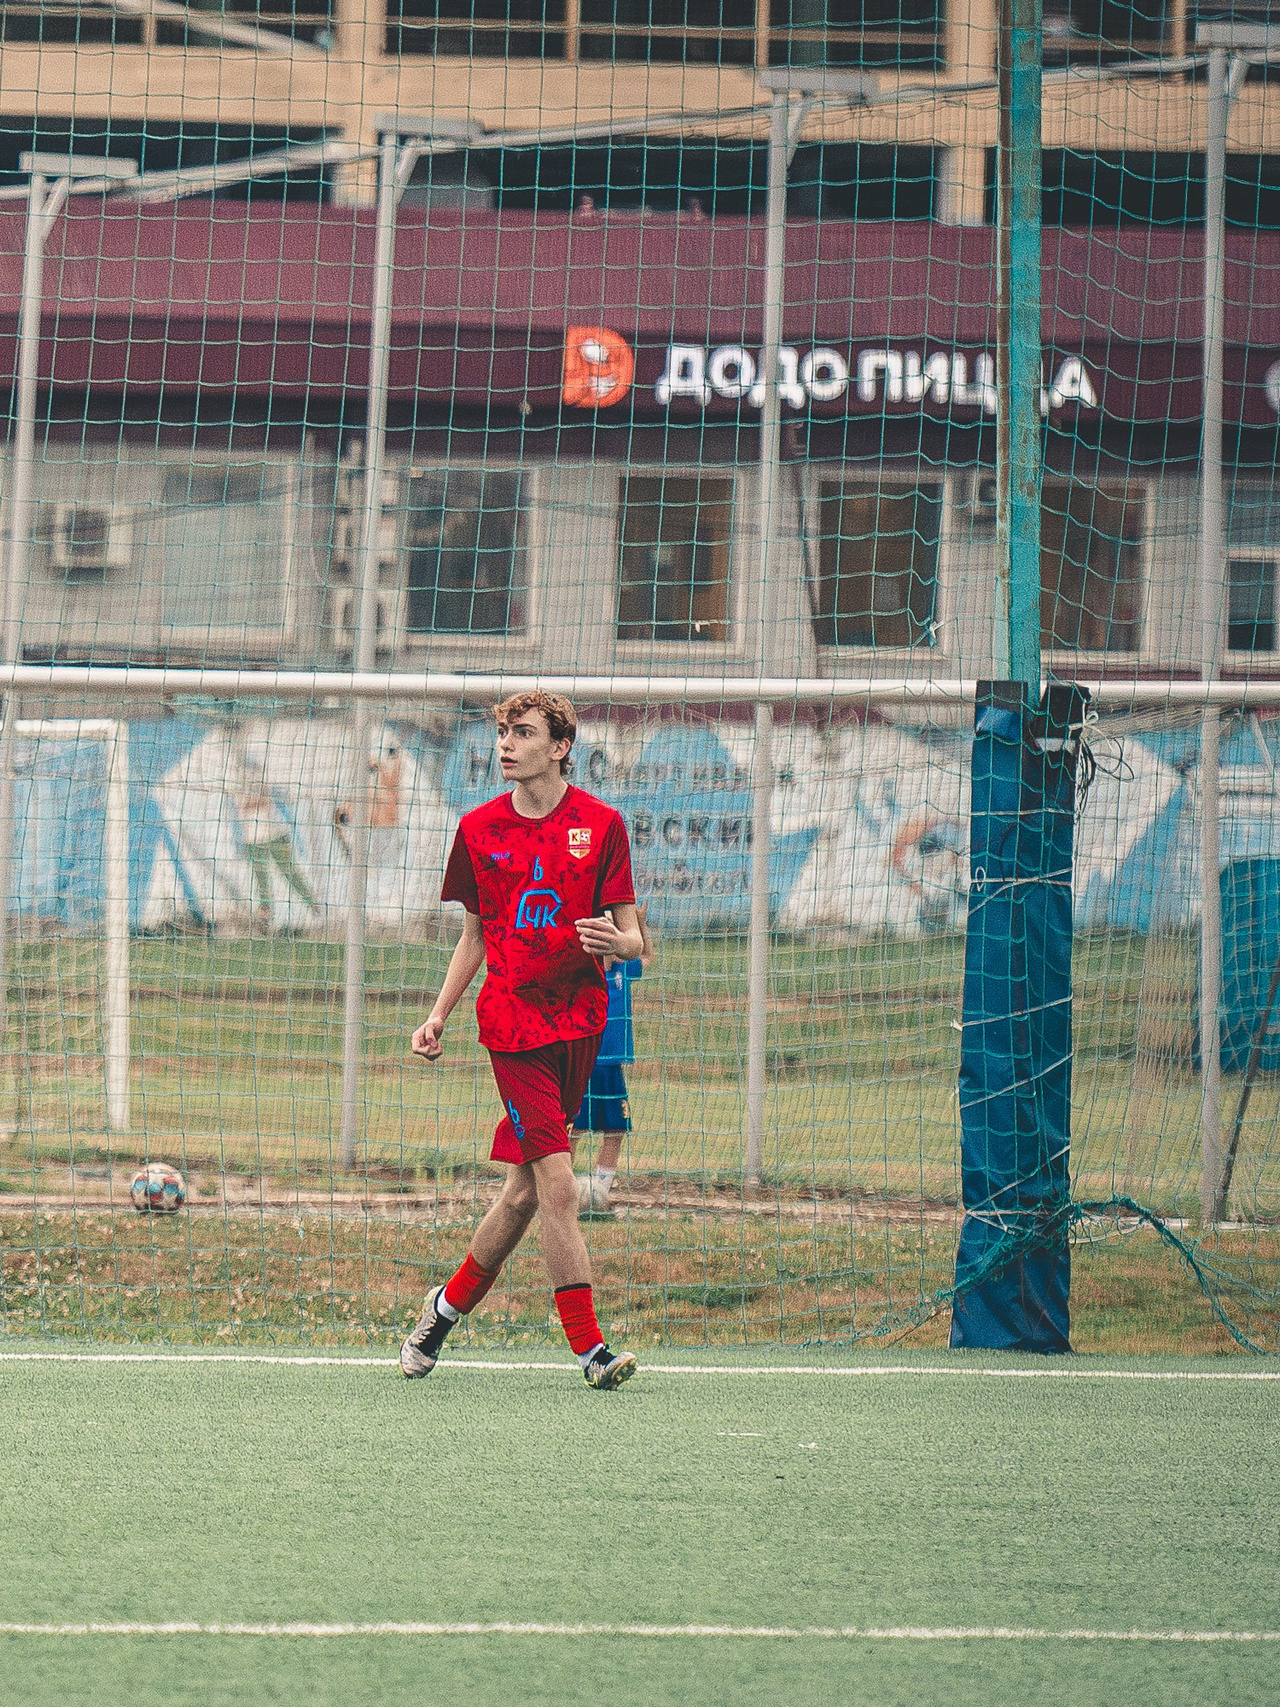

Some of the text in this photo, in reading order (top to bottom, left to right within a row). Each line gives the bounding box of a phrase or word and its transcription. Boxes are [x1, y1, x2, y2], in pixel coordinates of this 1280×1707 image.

[857, 349, 1098, 417] ПИЦА
[533, 855, 544, 882] 6
[506, 1098, 520, 1124] 6
